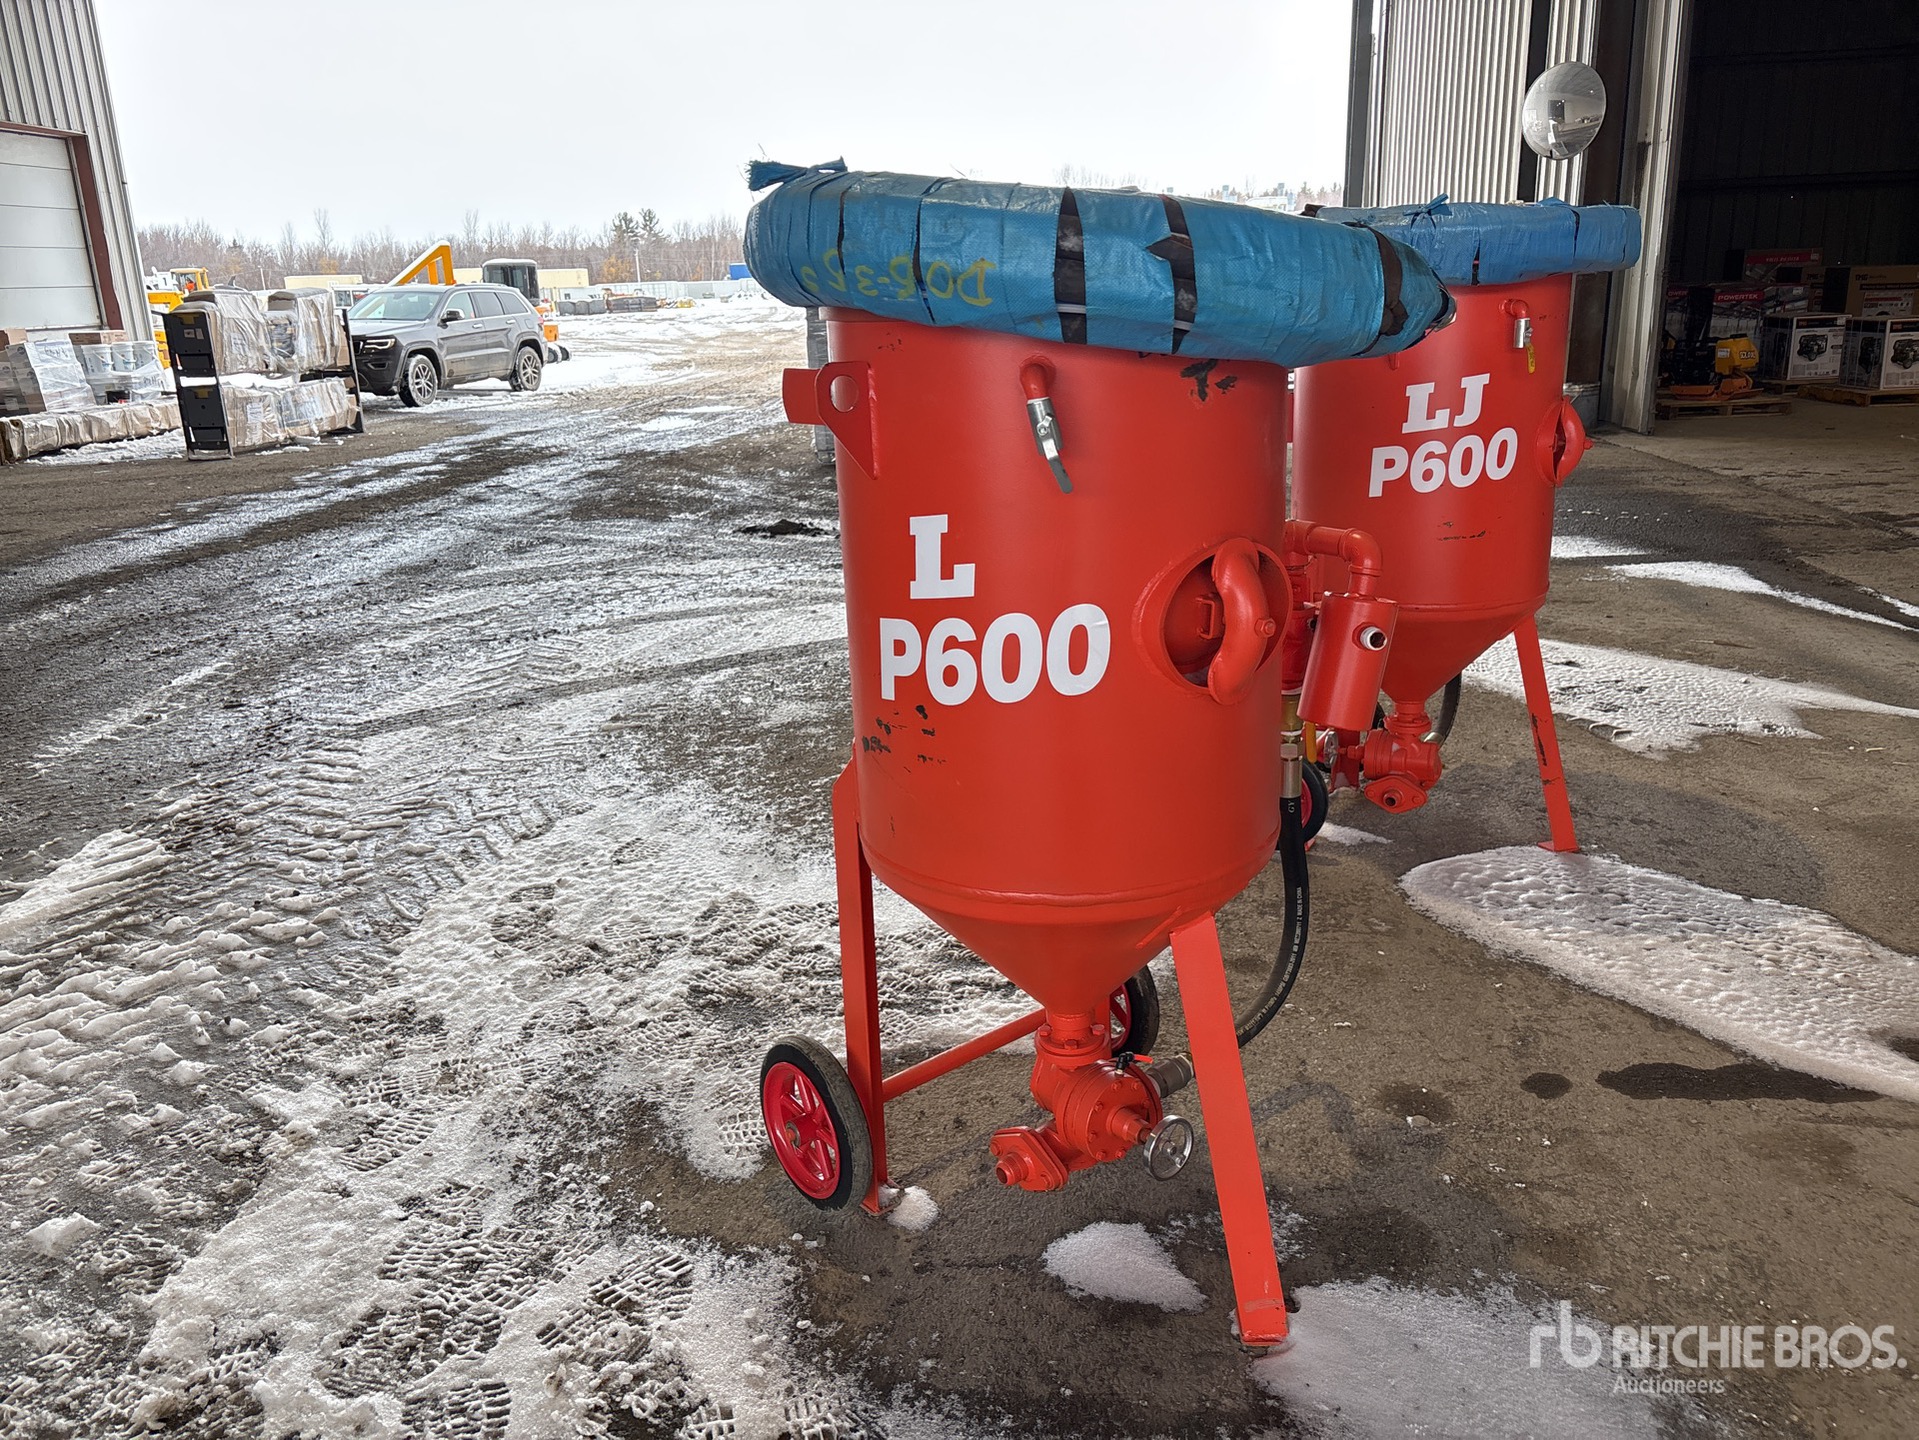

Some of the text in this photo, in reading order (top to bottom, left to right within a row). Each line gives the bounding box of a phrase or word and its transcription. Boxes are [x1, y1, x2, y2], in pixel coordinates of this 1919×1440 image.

[1717, 293, 1759, 301] POWERTEK
[1402, 373, 1490, 434] LJ
[1369, 427, 1518, 498] P600
[909, 514, 975, 599] L
[879, 603, 1111, 706] P600
